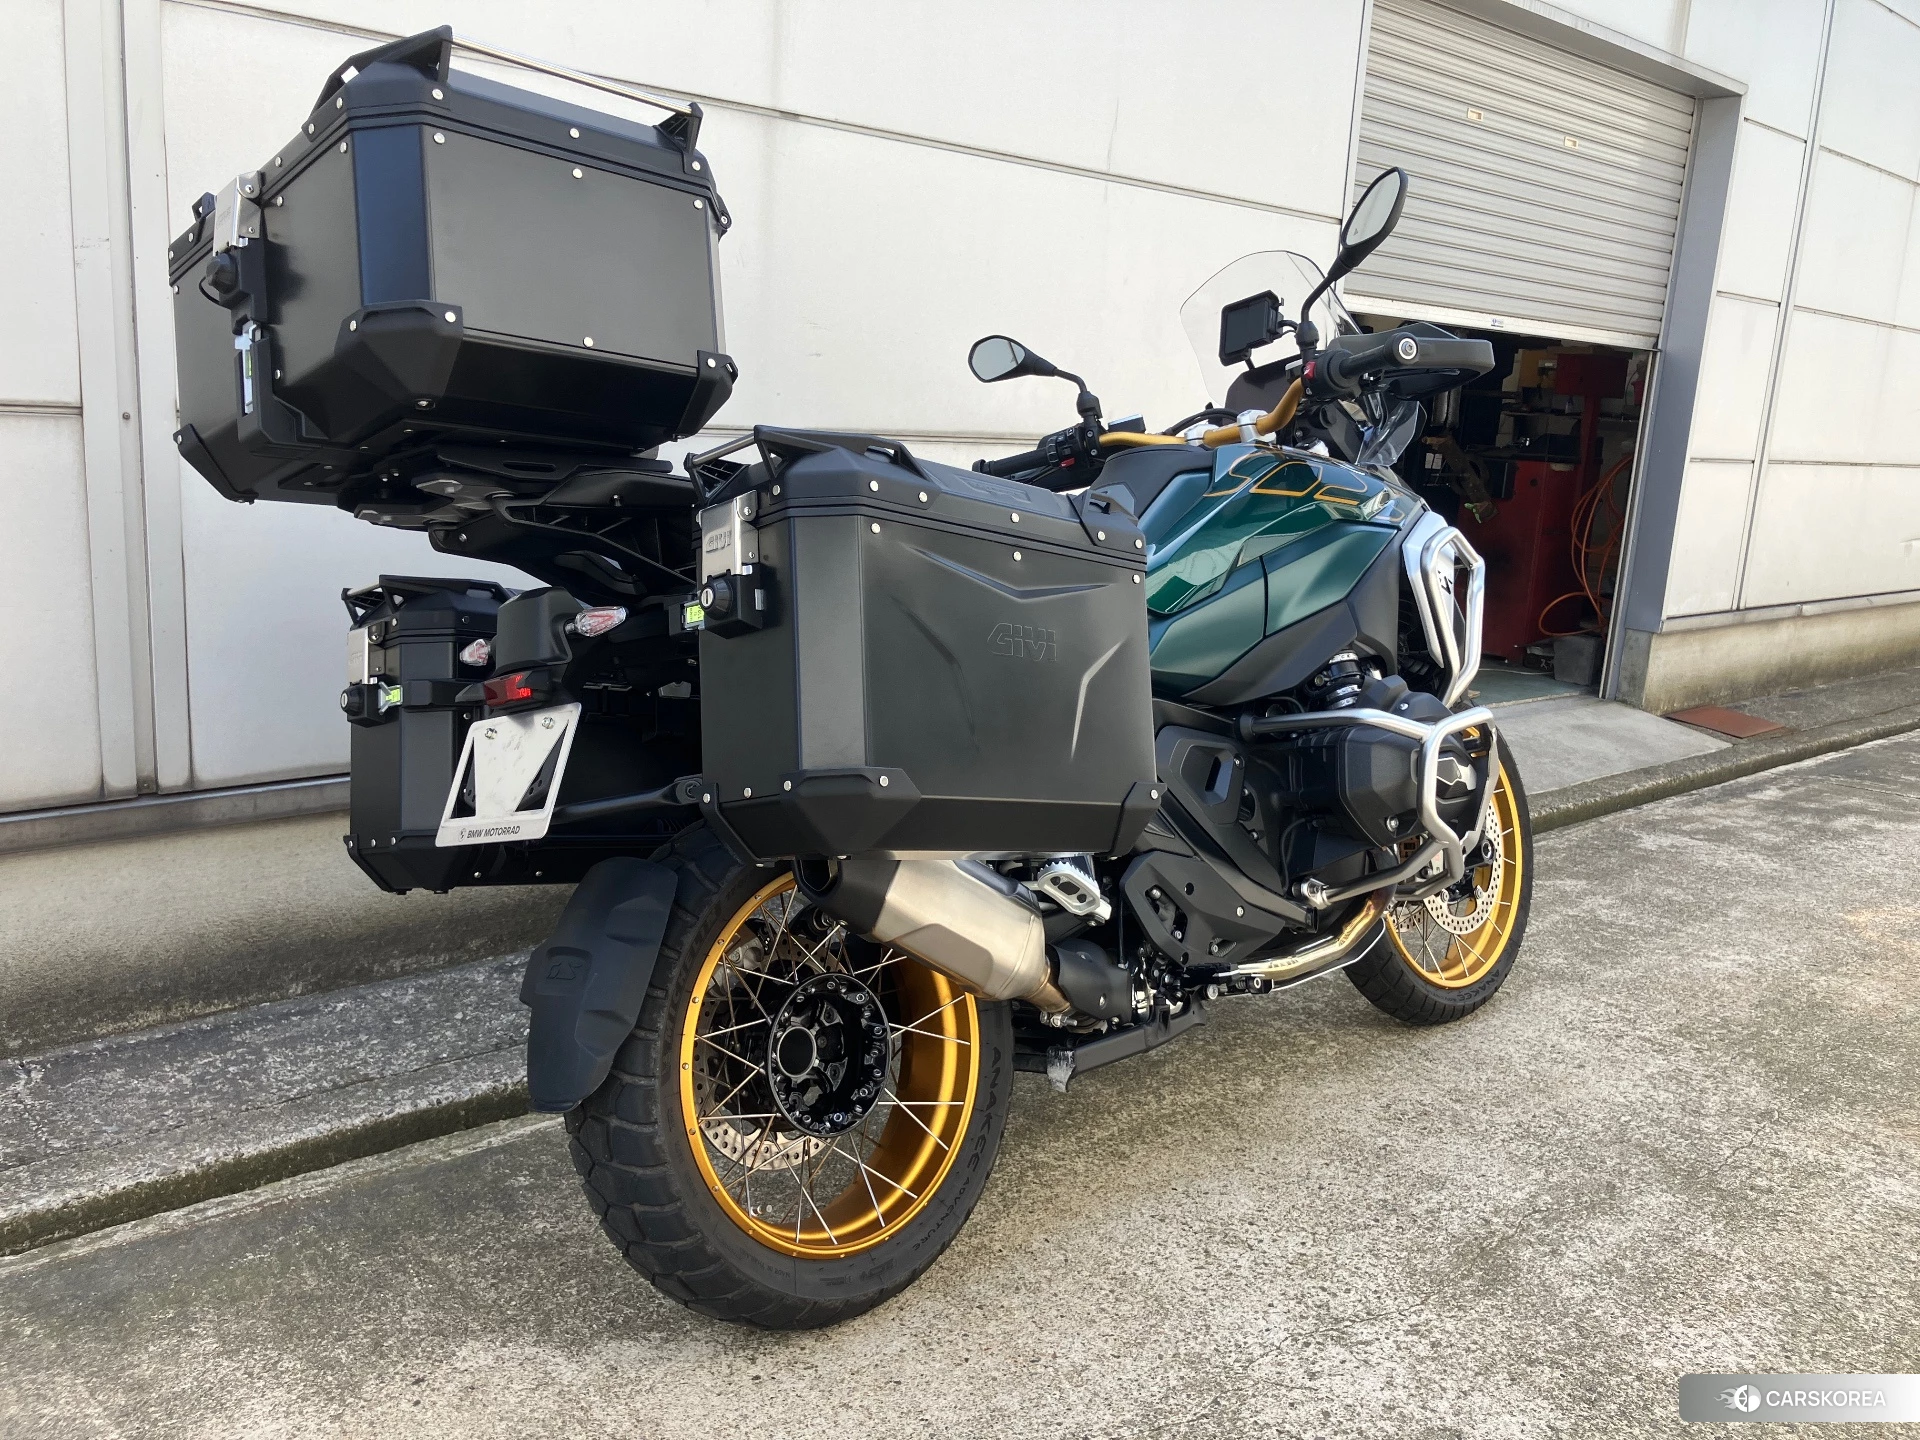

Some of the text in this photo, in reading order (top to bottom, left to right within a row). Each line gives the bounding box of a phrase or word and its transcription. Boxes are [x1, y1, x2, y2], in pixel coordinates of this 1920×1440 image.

[705, 528, 733, 554] GIVI
[987, 623, 1056, 661] GIVI
[466, 825, 521, 839] BMW MOTORRAD
[1456, 968, 1500, 1001] ANAKEE
[912, 1046, 1002, 1251] ANAKEE ADVENTURE
